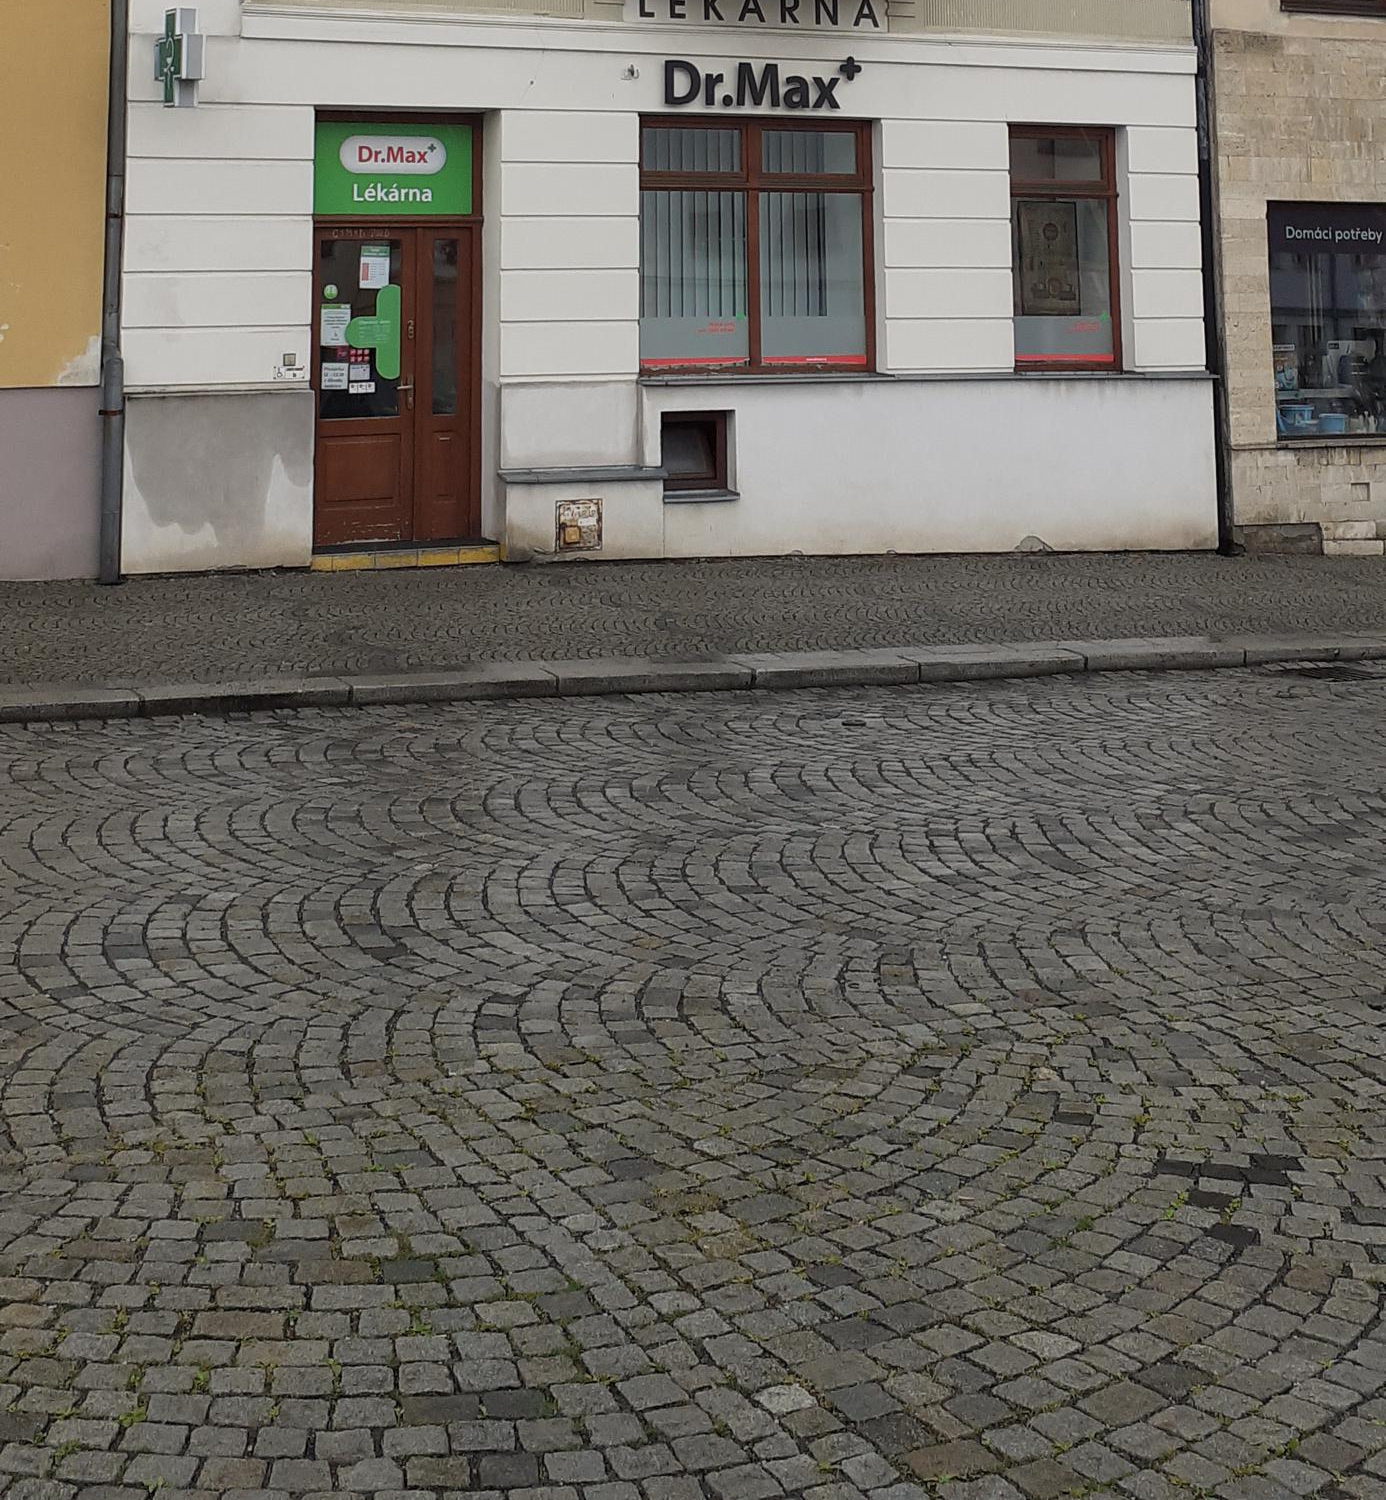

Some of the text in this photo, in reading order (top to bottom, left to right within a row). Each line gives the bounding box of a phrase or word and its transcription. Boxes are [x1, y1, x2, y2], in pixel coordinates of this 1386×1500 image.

[352, 183, 433, 202] Lékárna
[1285, 226, 1383, 244] Domácí potřeby
